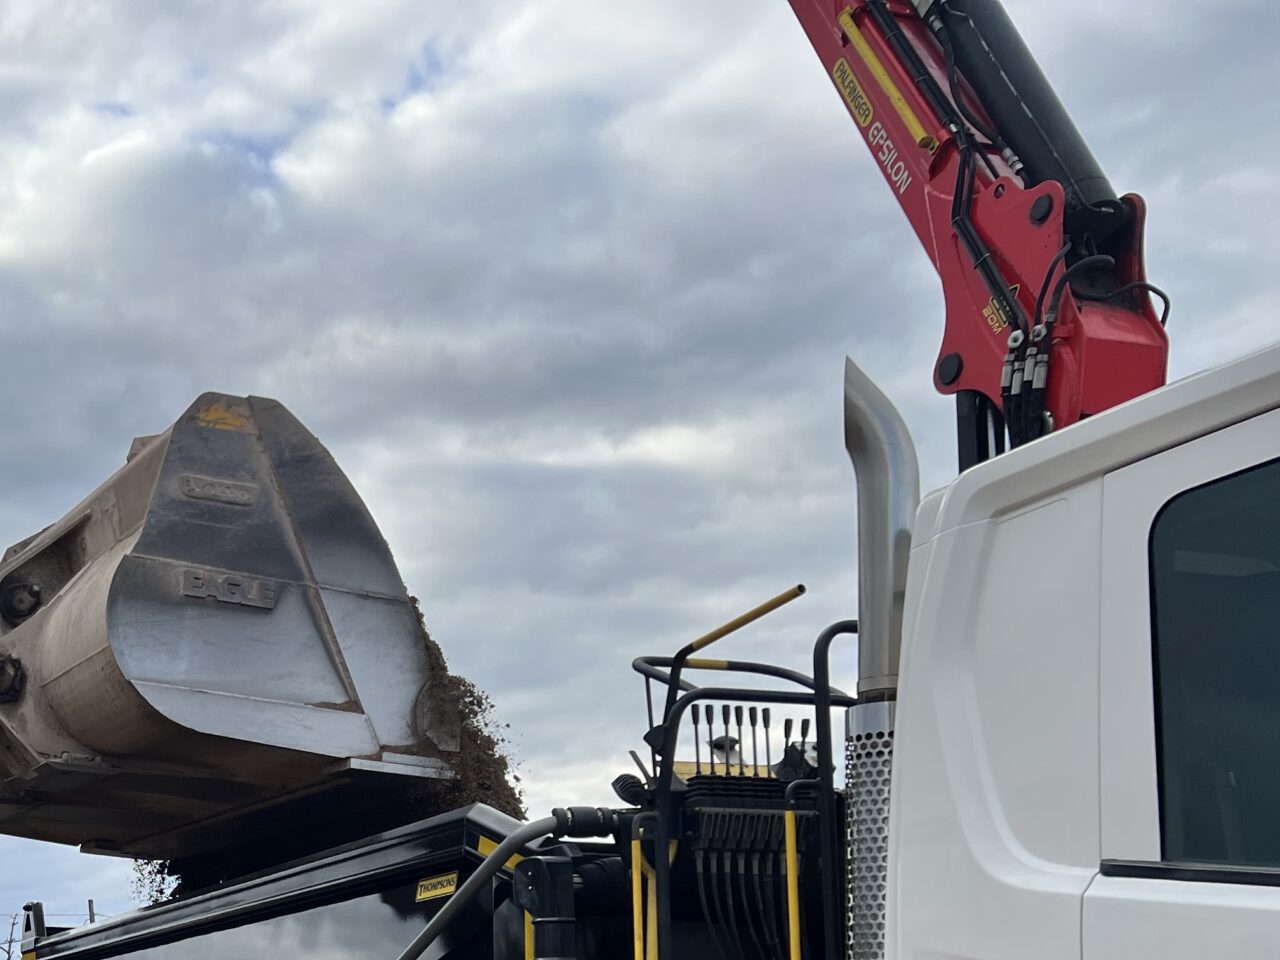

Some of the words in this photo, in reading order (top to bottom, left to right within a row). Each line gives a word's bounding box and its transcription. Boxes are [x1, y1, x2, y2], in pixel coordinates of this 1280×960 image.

[834, 60, 872, 125] PALFINGER
[868, 121, 913, 195] EPSILON
[419, 876, 456, 896] THOMPSONS
